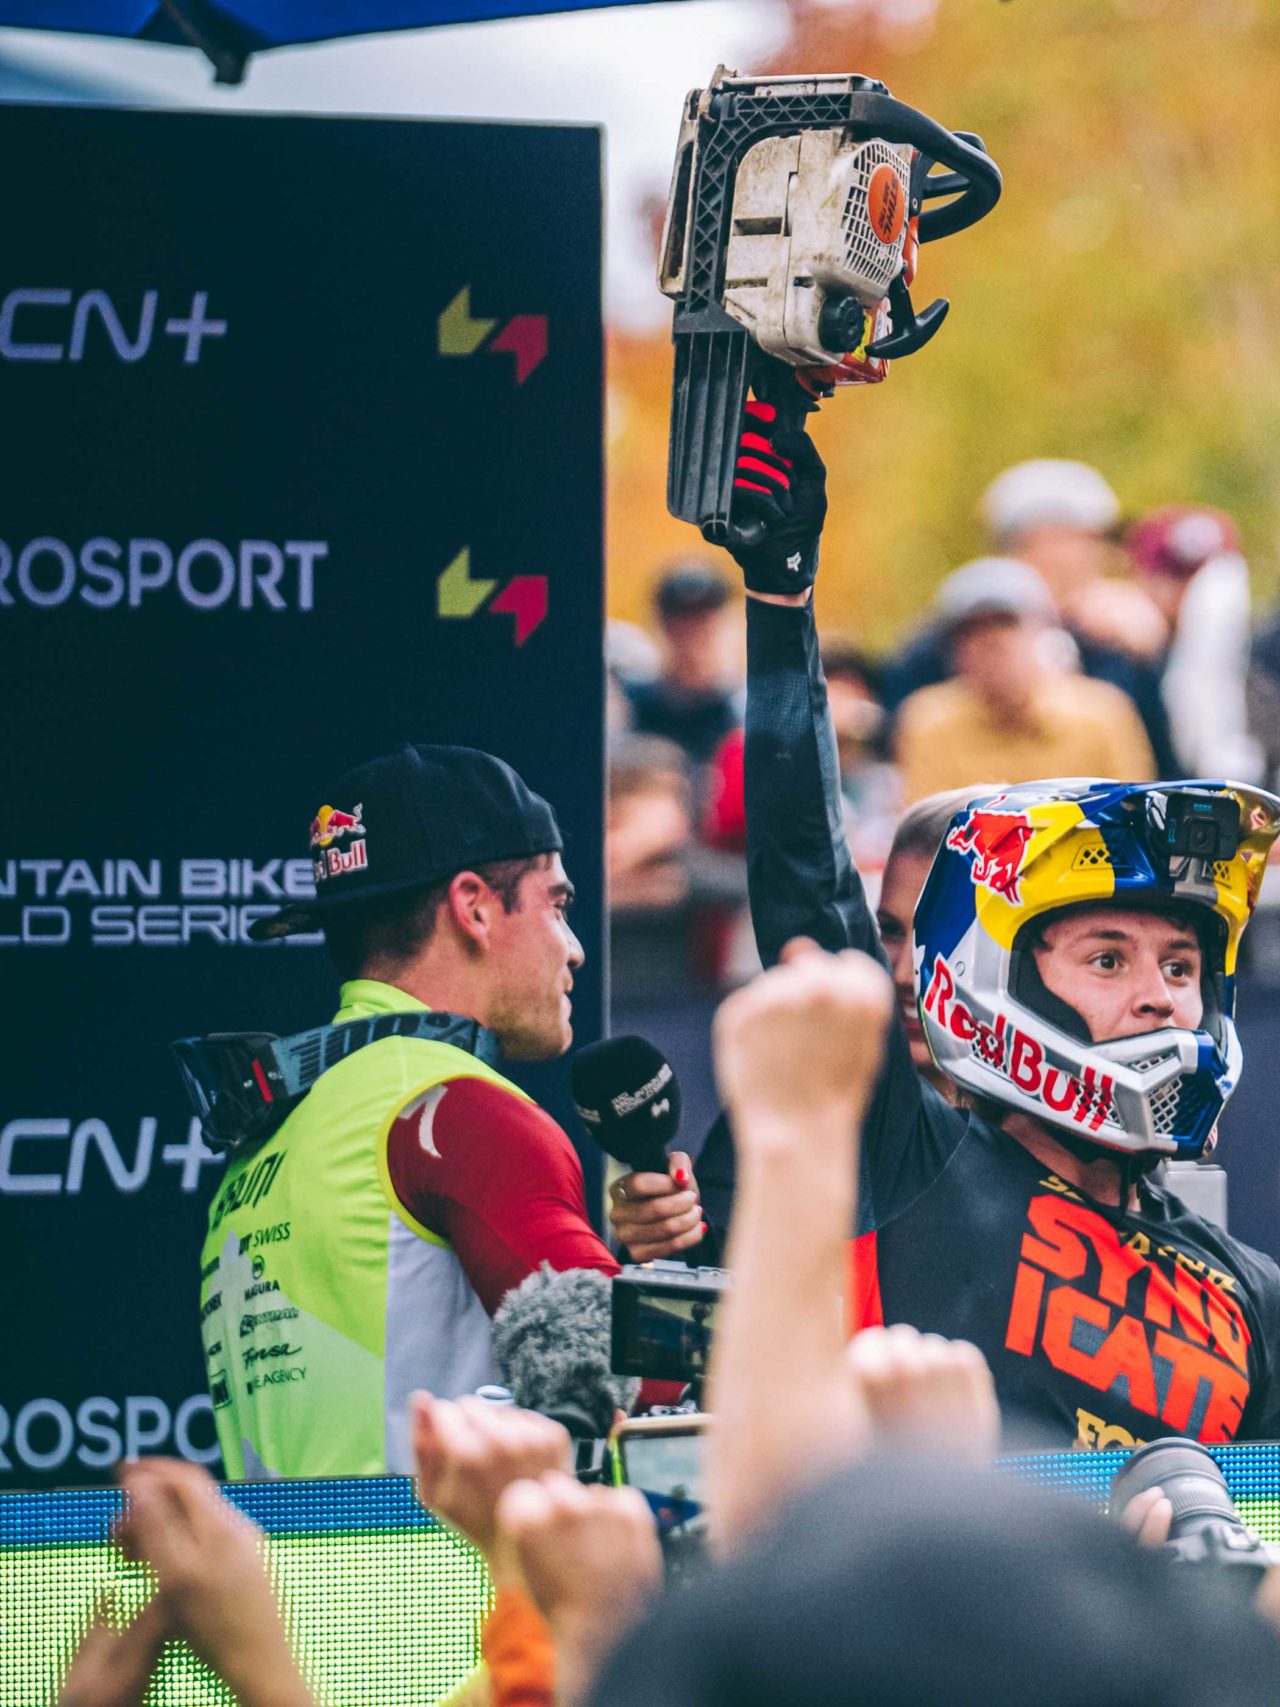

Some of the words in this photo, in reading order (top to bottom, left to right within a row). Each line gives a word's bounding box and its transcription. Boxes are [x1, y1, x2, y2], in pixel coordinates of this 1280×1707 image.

[180, 857, 317, 898] BIKE
[327, 838, 368, 877] Bull
[91, 904, 326, 945] SERIE
[253, 1221, 291, 1248] SWISS
[0, 1393, 221, 1469] OSPO
